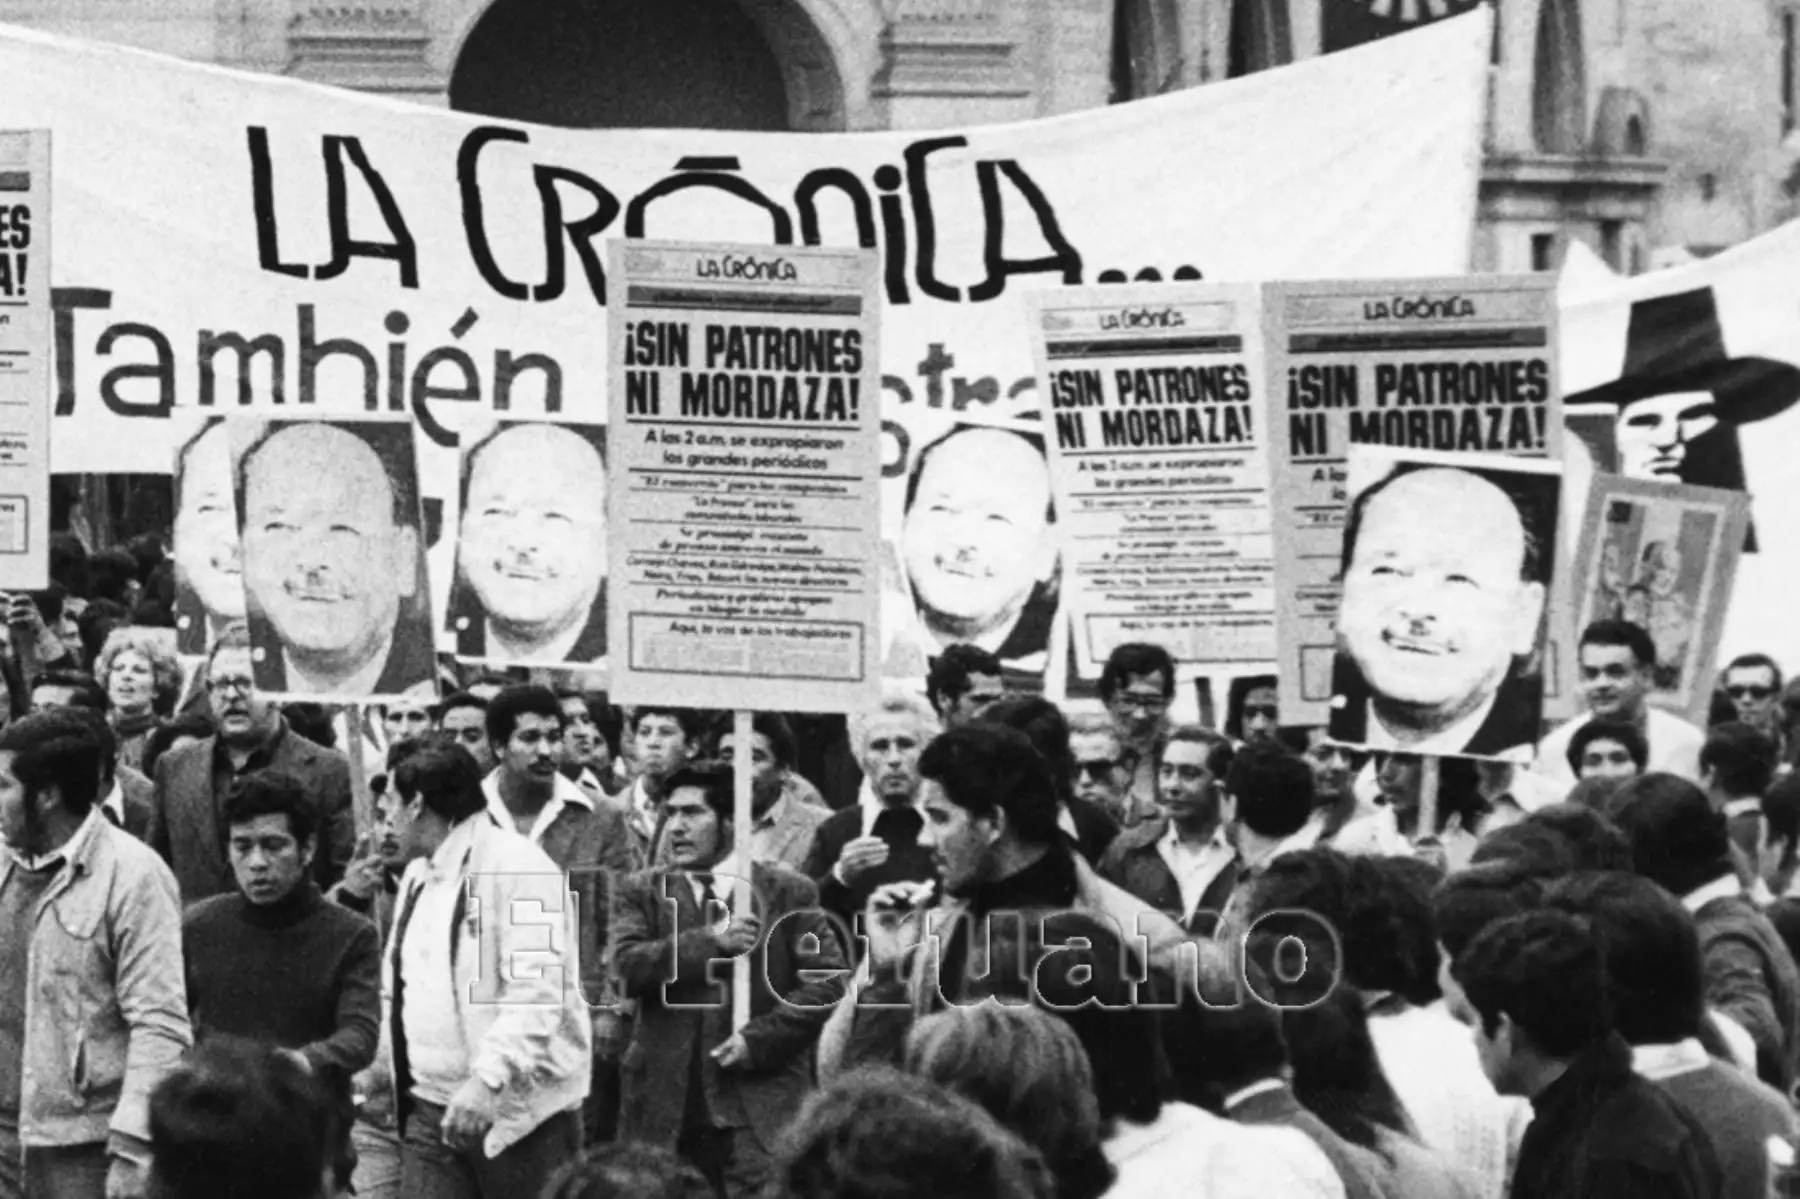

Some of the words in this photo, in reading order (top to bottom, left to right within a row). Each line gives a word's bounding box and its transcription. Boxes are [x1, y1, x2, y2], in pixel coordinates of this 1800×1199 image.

[247, 125, 418, 288] LA
[696, 258, 719, 278] LA
[1363, 301, 1388, 320] LA
[624, 319, 689, 367] ¡SIN
[706, 324, 862, 374] PATRONES
[625, 370, 659, 415] NI
[680, 372, 860, 421] MORDAZA!
[1049, 368, 1104, 408] ¡SIN
[1115, 363, 1250, 406] PATRONES
[1287, 363, 1358, 410] ¡SIN
[1375, 358, 1548, 407] PATRONES
[644, 427, 657, 444] A
[661, 427, 682, 445] las
[684, 429, 694, 445] 2
[730, 435, 747, 448] se
[749, 433, 845, 452] expropiaron
[1055, 410, 1086, 449] NI
[1100, 405, 1253, 447] MORDAZA!
[1289, 412, 1328, 456] NI
[1350, 405, 1547, 452] MORDAZA!
[663, 449, 684, 465] los
[686, 452, 748, 469] grandes
